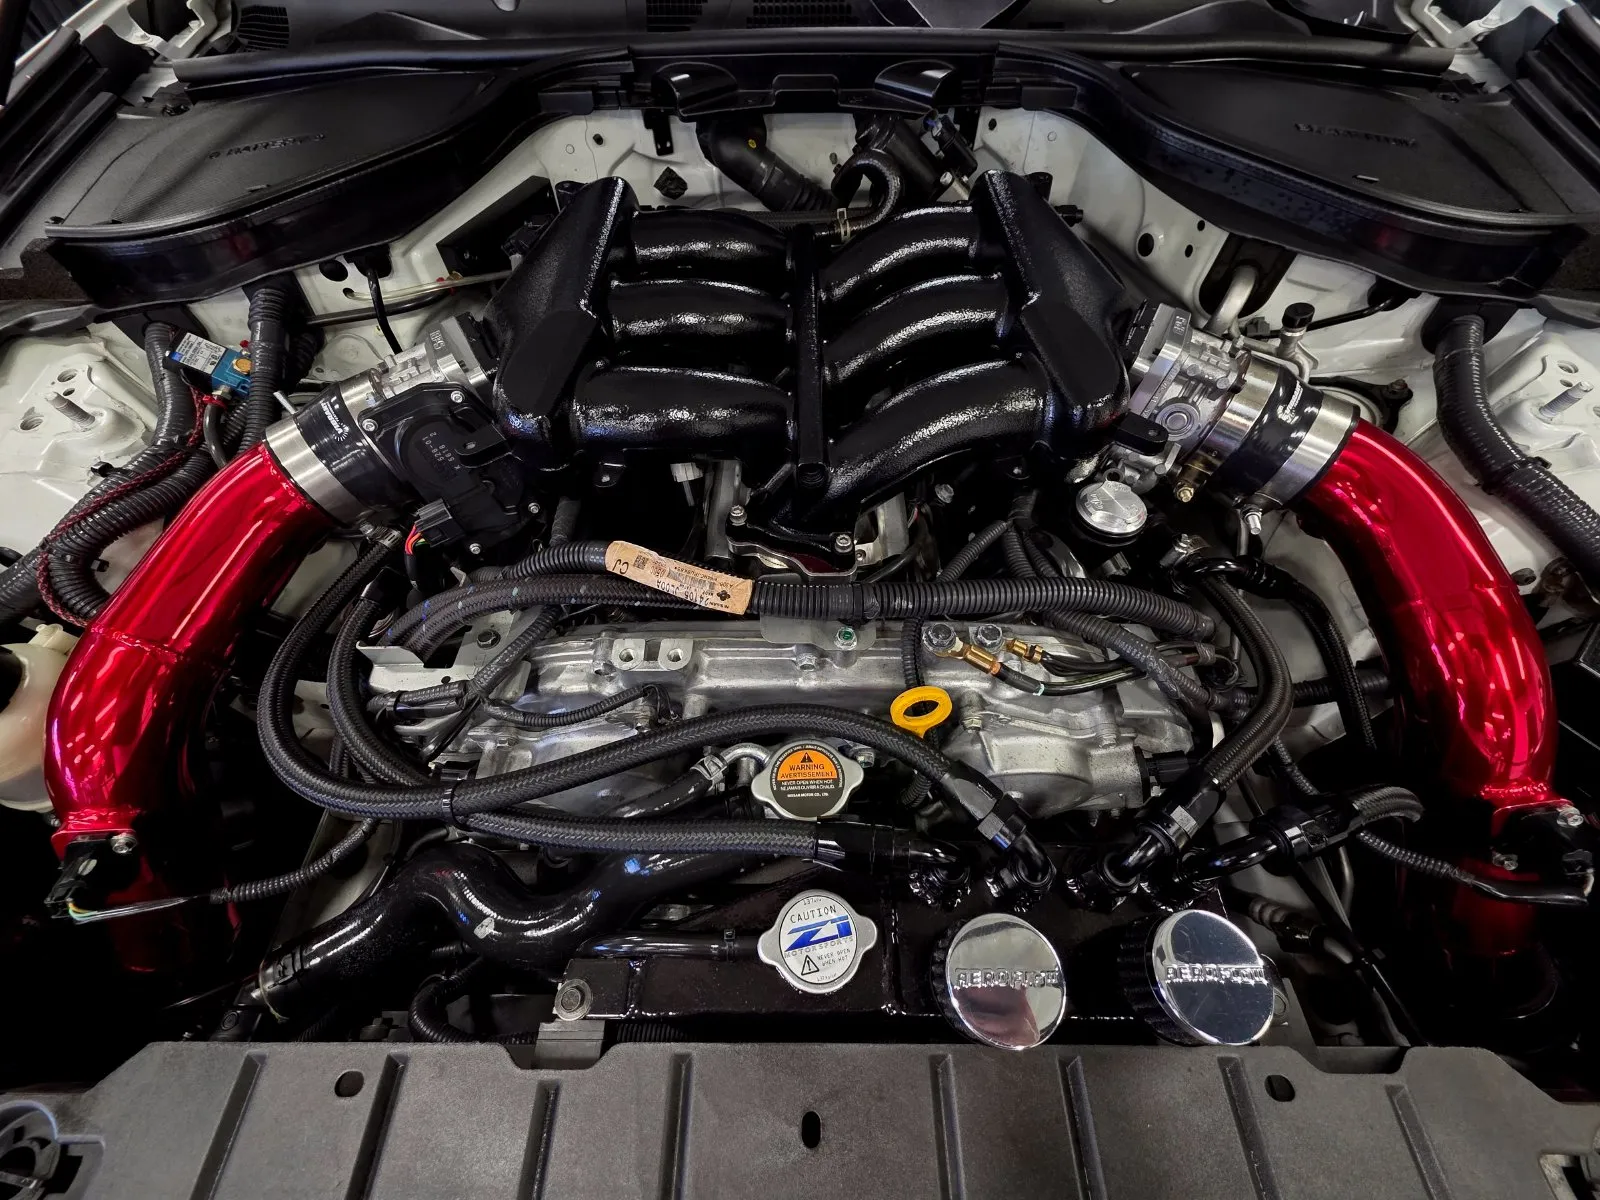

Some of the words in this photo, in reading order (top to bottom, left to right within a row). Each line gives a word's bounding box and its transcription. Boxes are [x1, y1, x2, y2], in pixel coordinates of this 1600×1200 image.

[319, 400, 343, 434] VIBRANT
[612, 559, 629, 574] CJ
[780, 771, 833, 779] AVERTISSEMENT
[789, 763, 825, 771] WARNING
[790, 904, 837, 924] CAUTION
[784, 937, 854, 959] MOTORSPORTS
[816, 952, 834, 961] NEVER
[837, 948, 851, 957] OPEN
[822, 959, 836, 967] WHEN
[838, 955, 849, 963] HOT
[955, 966, 1062, 988] AEROFLOW
[1165, 964, 1268, 985] AEROFLOW
